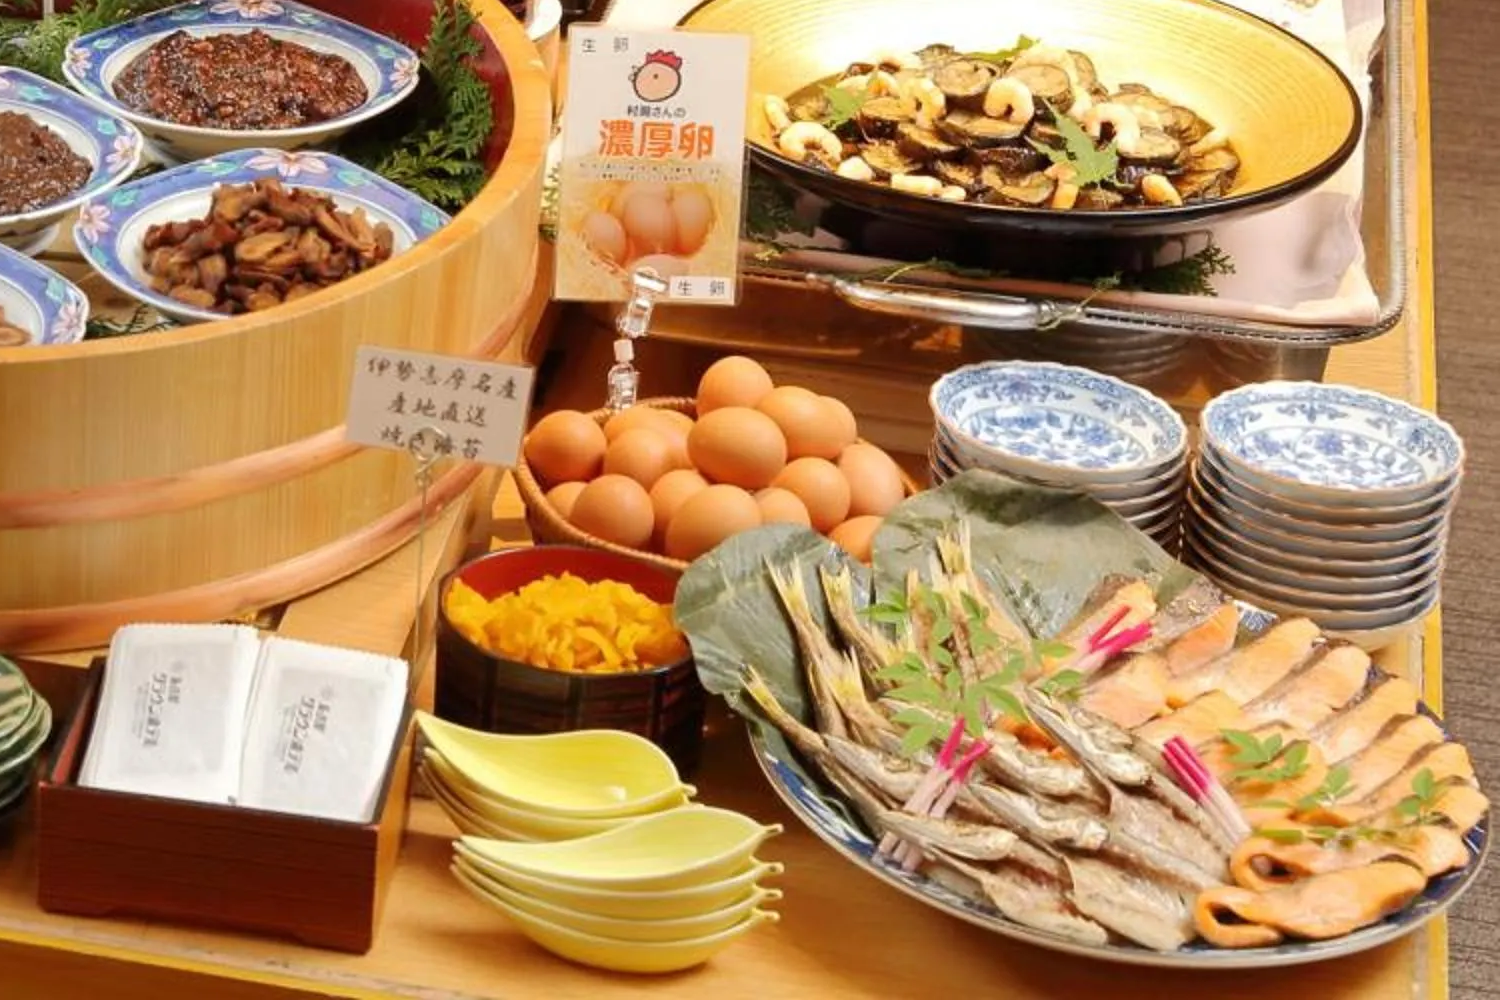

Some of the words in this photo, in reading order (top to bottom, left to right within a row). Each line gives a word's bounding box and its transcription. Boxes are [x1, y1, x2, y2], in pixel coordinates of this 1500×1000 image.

[599, 119, 715, 159] 濃厚卵
[387, 391, 487, 428] 産地直送
